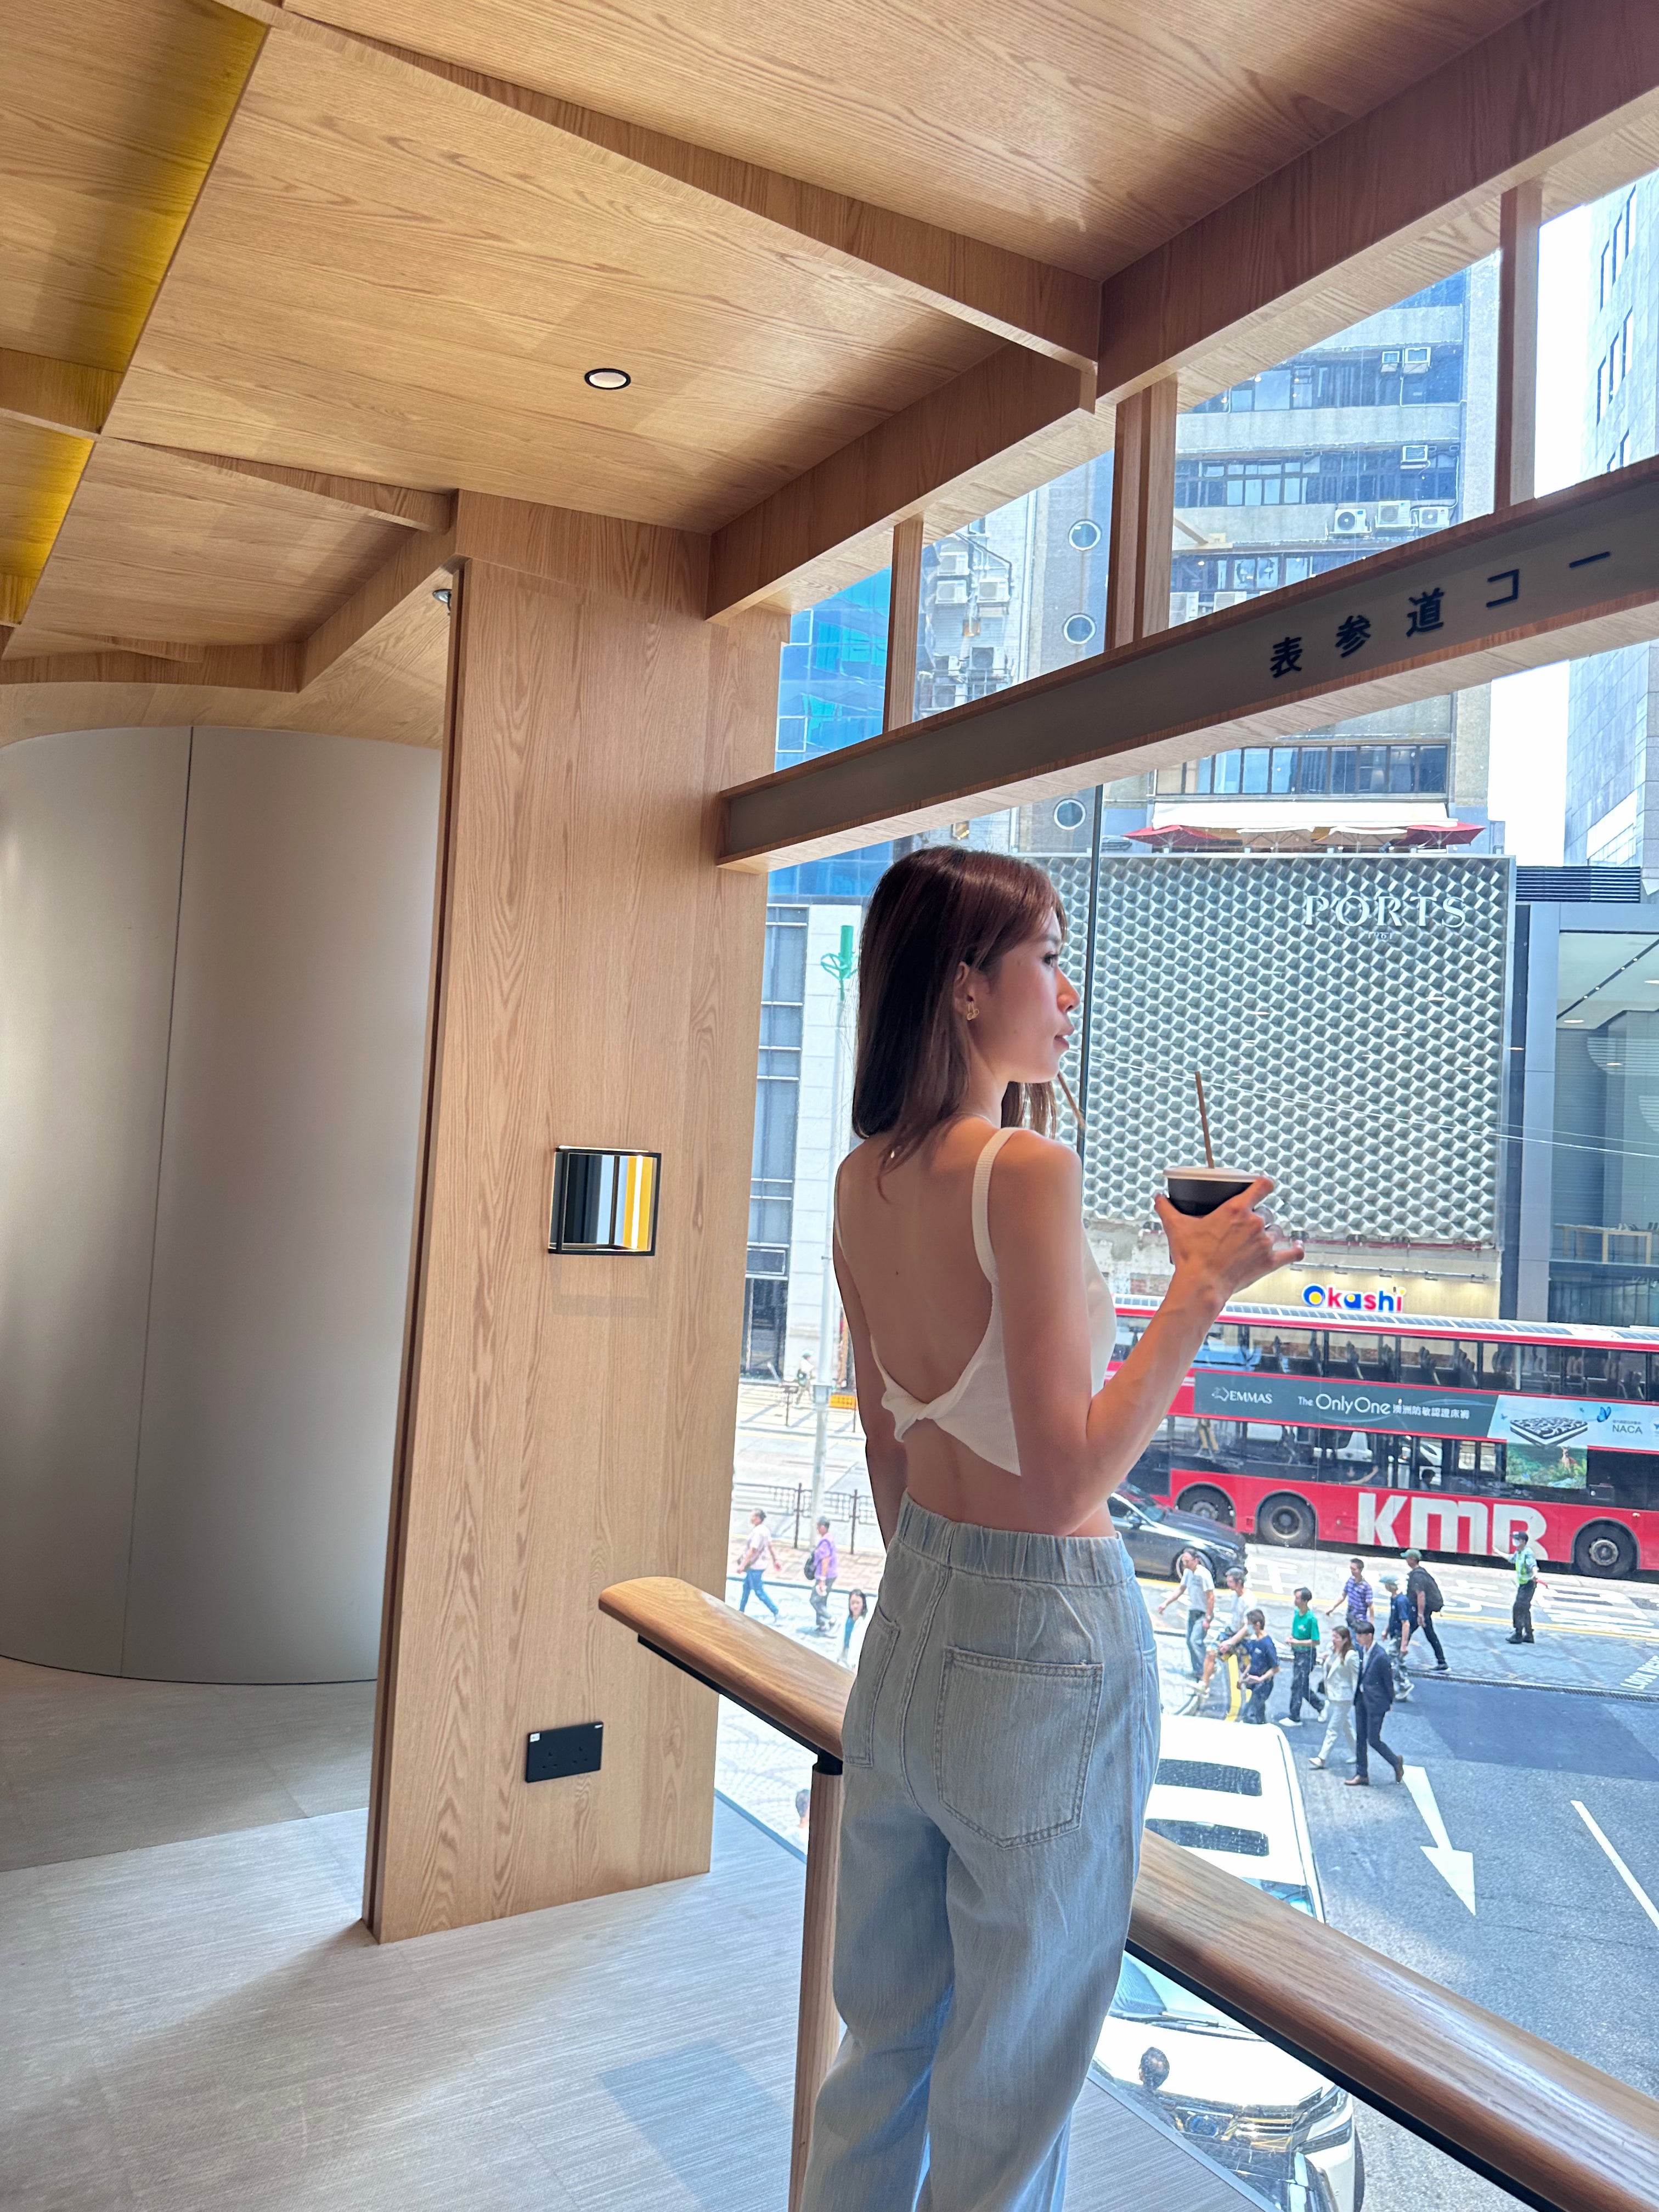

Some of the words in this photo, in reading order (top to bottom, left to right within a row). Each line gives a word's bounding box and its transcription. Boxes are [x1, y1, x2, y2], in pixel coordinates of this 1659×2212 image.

[1304, 895, 1466, 928] PORTS
[1302, 1284, 1407, 1312] Okashi
[1229, 1390, 1273, 1404] EMMAS
[1297, 1396, 1314, 1406] The
[1612, 1424, 1643, 1434] NACA
